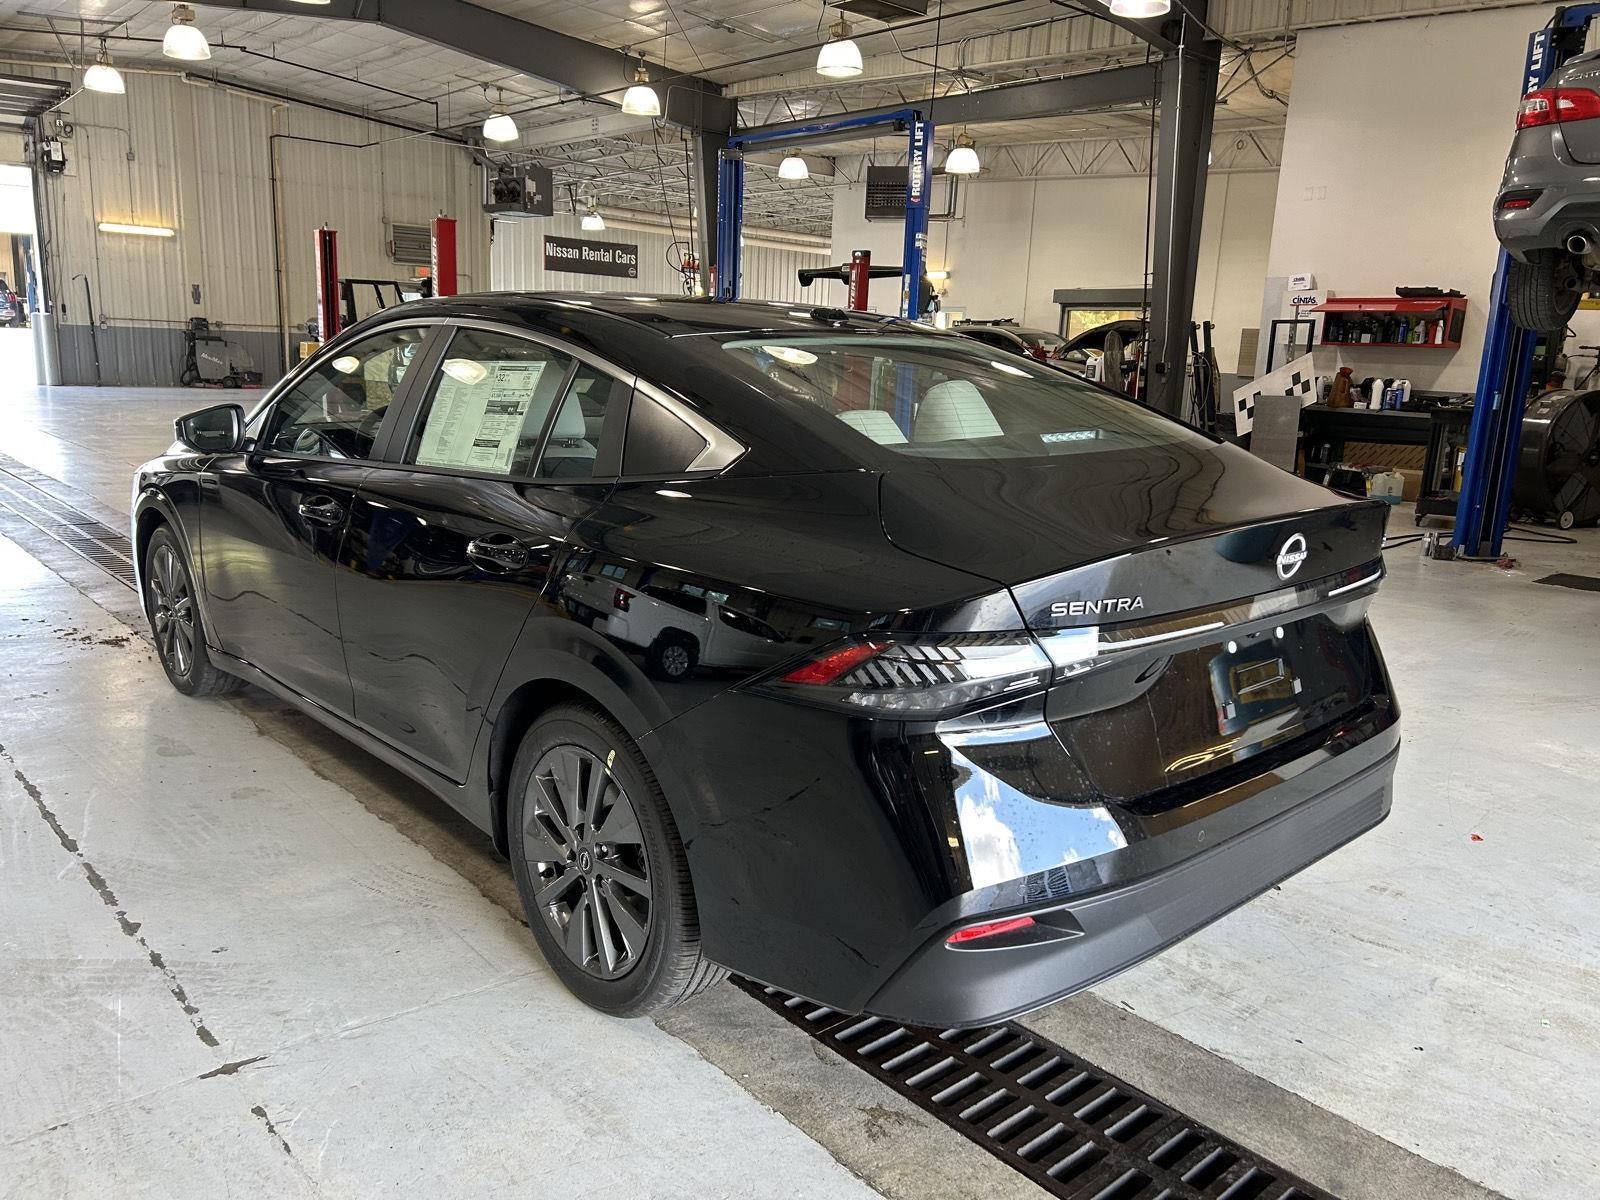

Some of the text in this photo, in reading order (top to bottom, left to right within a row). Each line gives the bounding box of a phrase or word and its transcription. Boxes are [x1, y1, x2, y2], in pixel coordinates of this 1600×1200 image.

[1531, 32, 1545, 70] LIFT
[911, 121, 925, 196] ROTARY LIFT
[545, 242, 636, 265] Nissan Rental Cars
[1050, 596, 1144, 617] SENTRA
